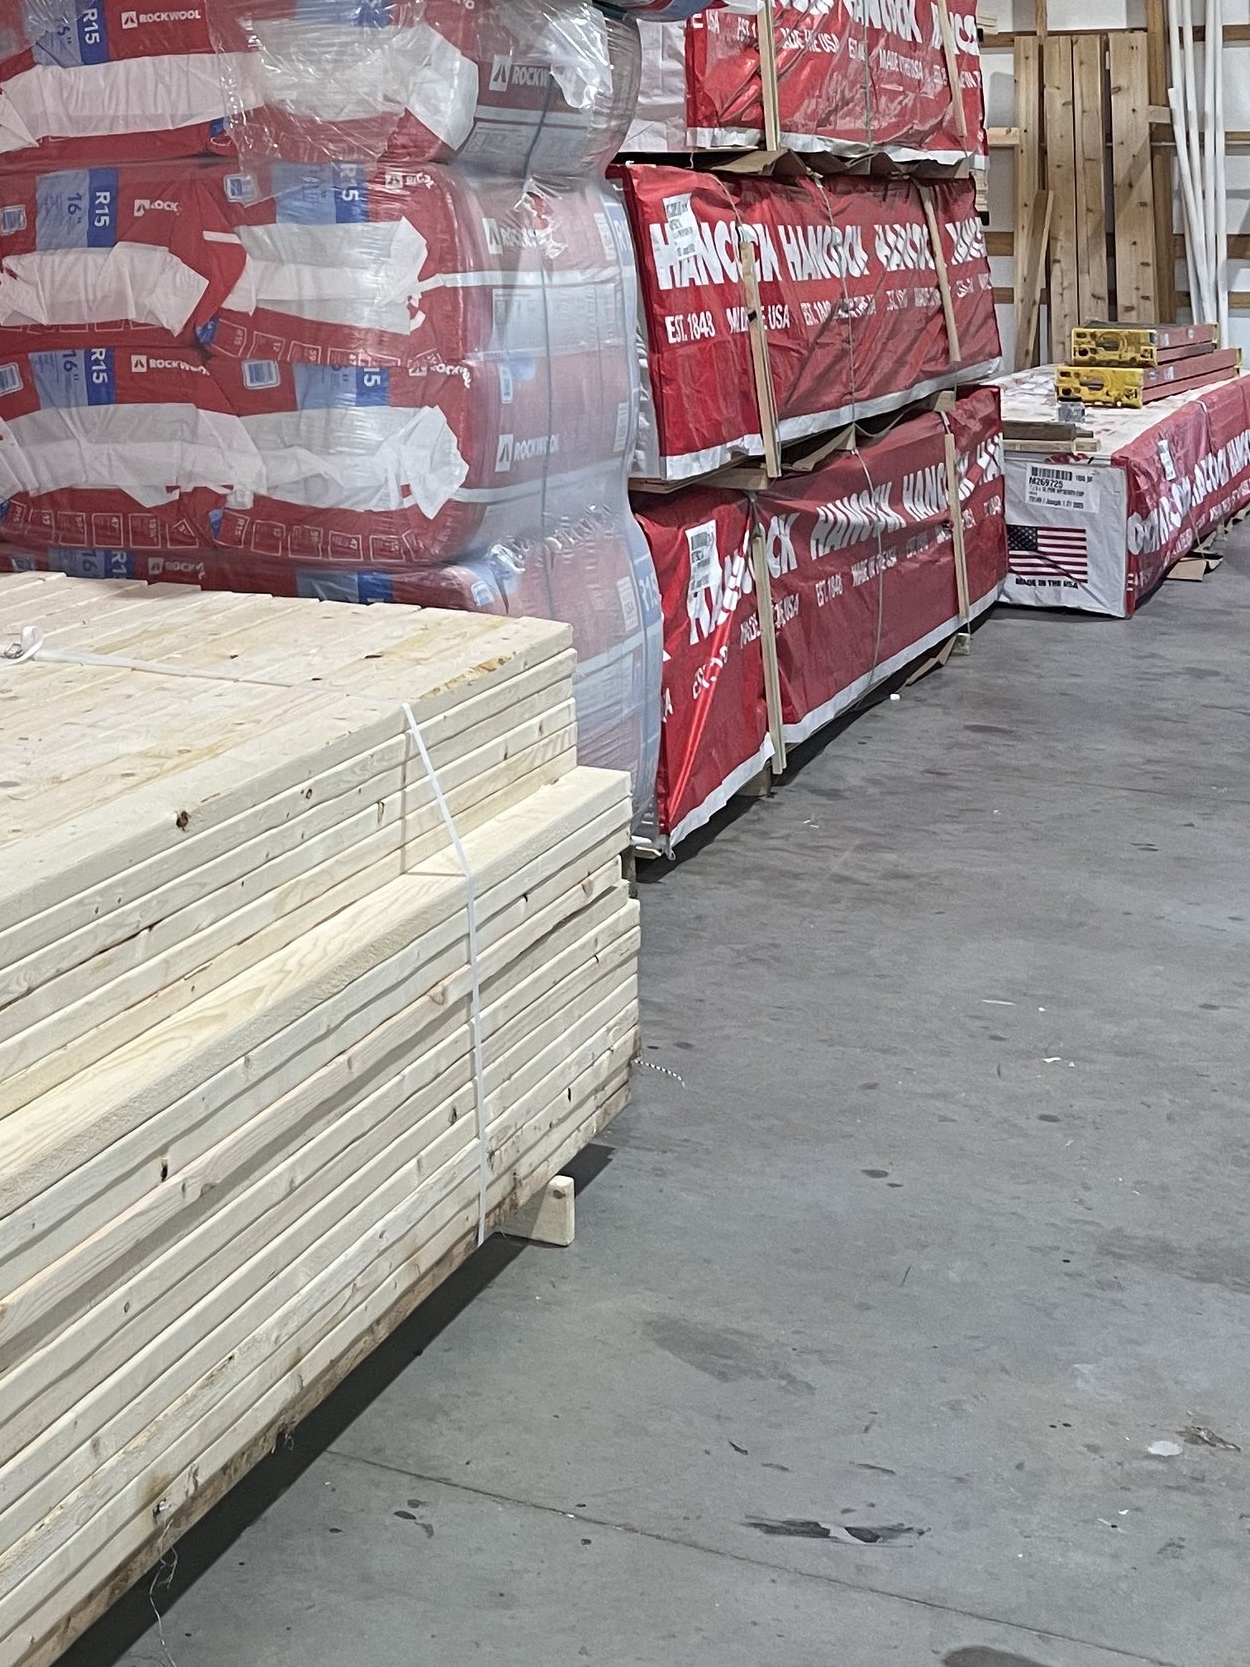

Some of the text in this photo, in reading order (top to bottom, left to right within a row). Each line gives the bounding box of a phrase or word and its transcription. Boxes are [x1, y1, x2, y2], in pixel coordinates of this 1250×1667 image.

[82, 7, 100, 46] R15
[139, 10, 201, 24] ROCKWOOL
[821, 32, 840, 55] USA
[94, 190, 111, 229] R15
[665, 315, 687, 345] EST.
[767, 304, 791, 331] USA
[91, 347, 110, 386] R15
[110, 551, 128, 575] R1
[1015, 577, 1038, 589] MADE
[1046, 578, 1063, 589] THE
